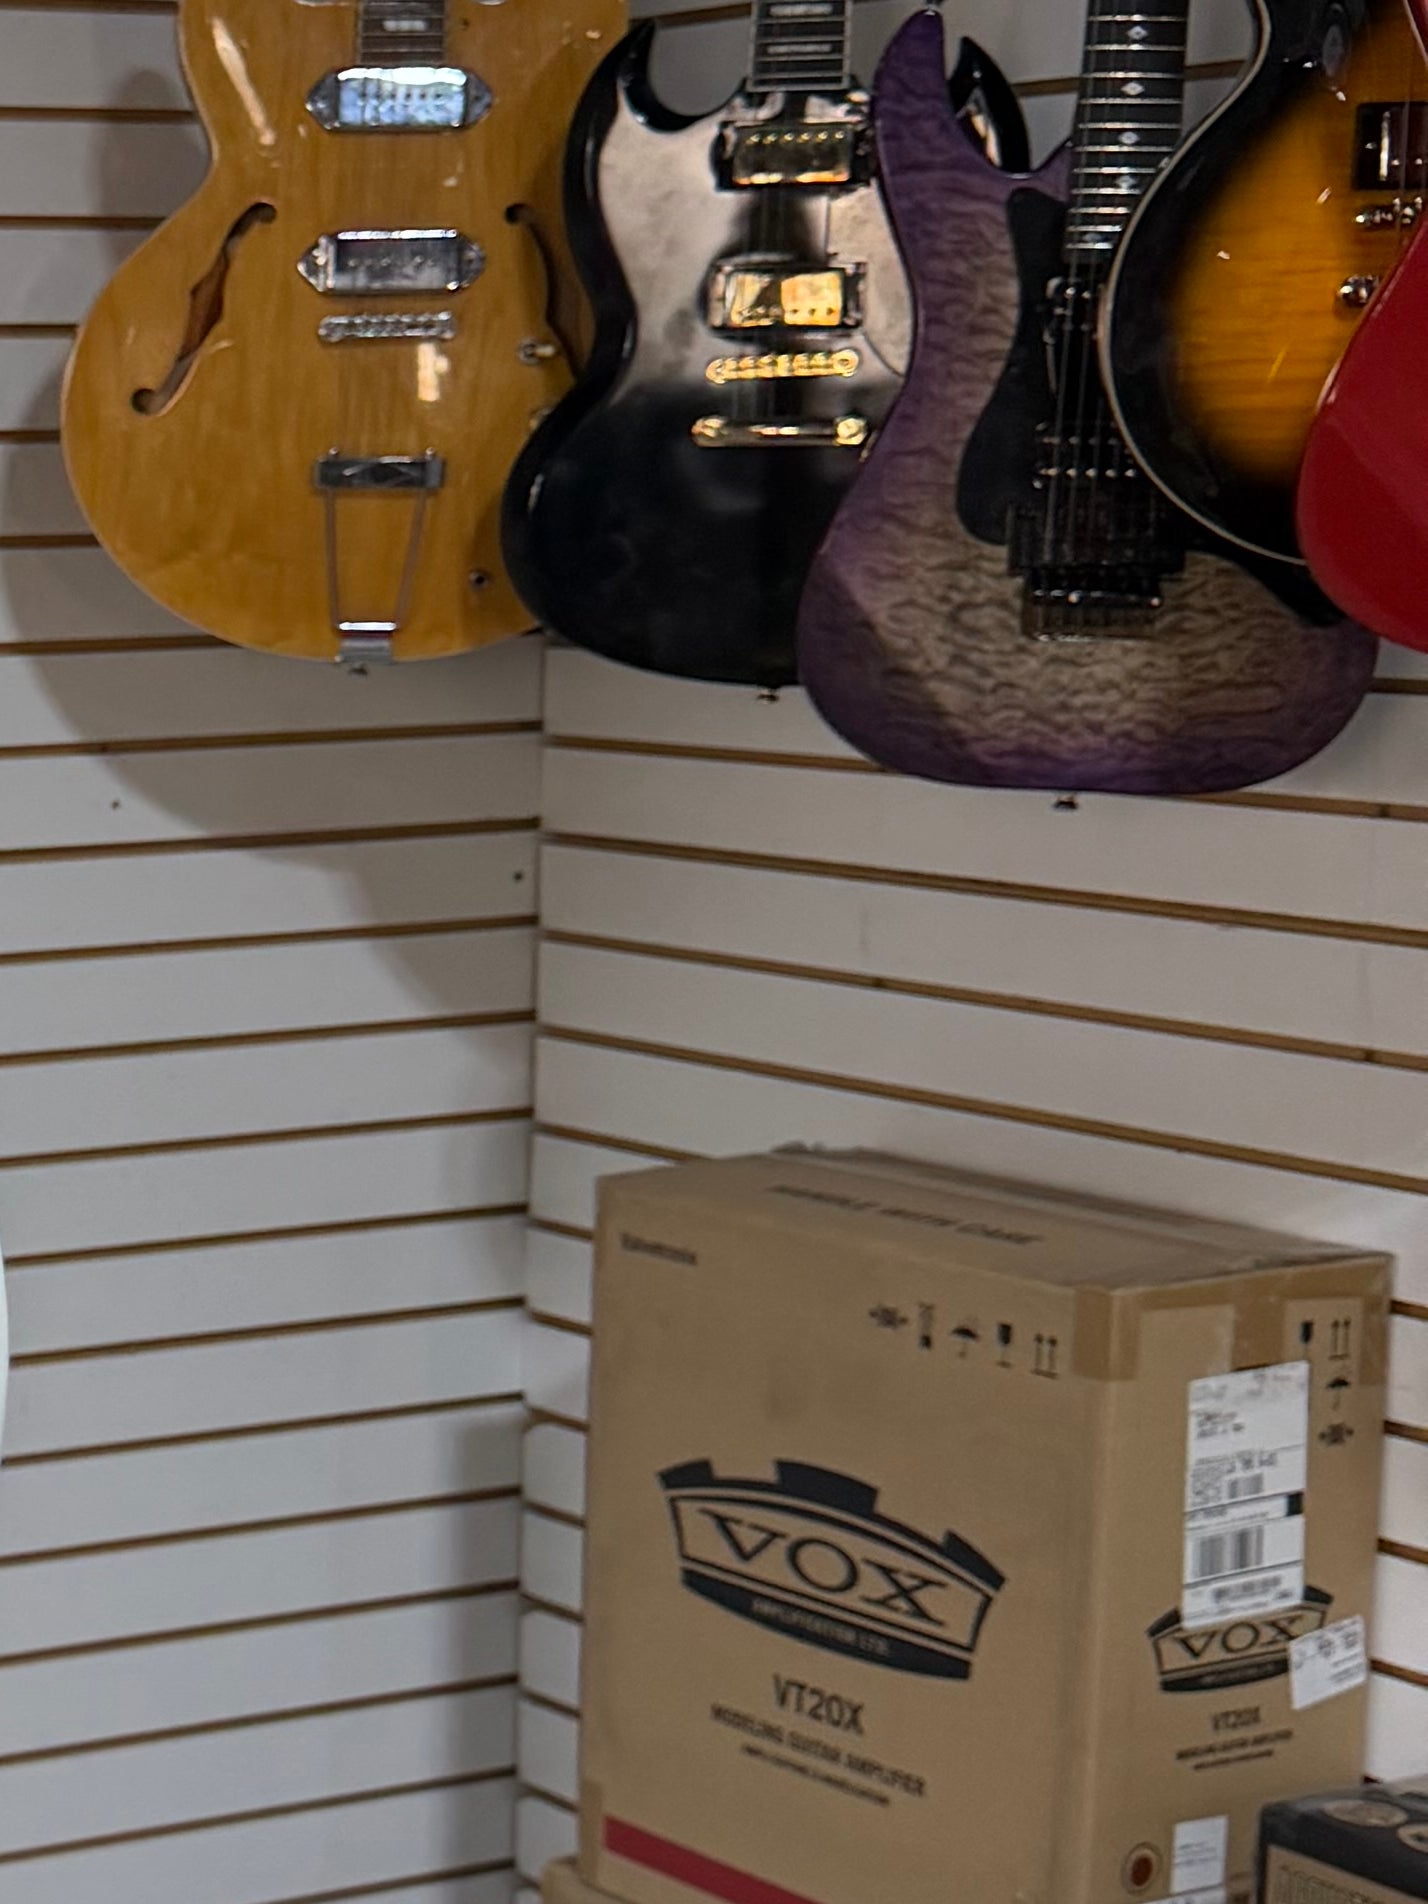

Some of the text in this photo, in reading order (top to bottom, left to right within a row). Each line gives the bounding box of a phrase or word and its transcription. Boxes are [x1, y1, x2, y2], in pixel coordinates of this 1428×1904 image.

[699, 1508, 949, 1628] VOX
[1177, 1614, 1304, 1661] VOX
[773, 1673, 867, 1735] VT20X
